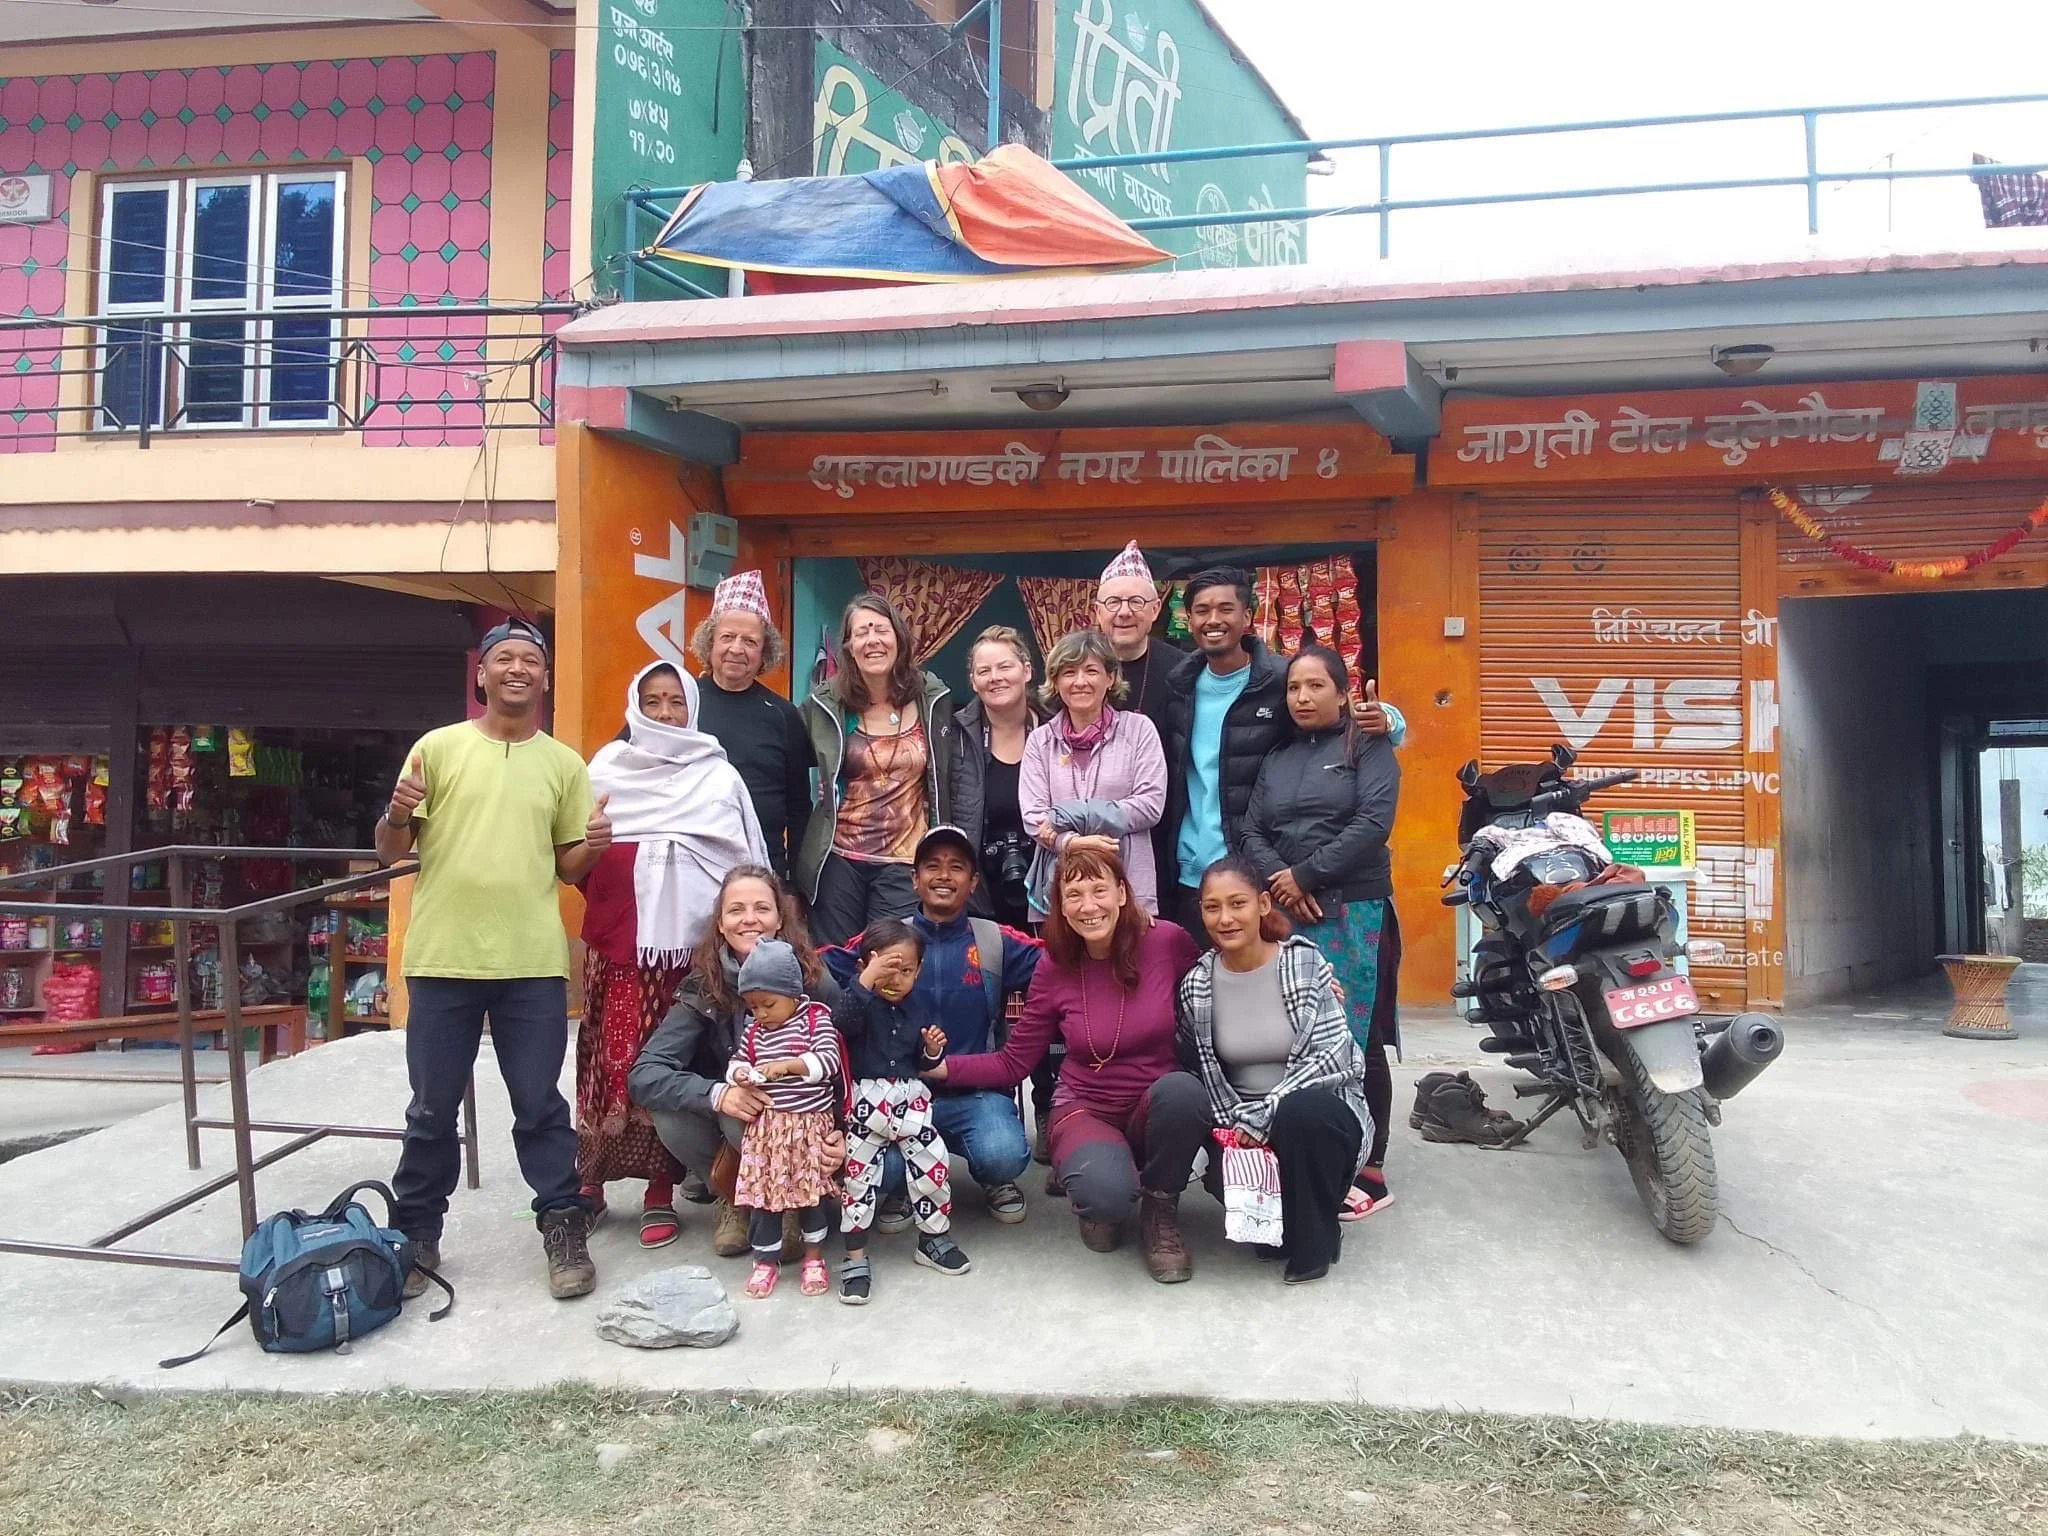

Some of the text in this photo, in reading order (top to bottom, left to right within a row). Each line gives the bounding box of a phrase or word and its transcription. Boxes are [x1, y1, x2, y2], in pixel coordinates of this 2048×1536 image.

[1457, 409, 1600, 469] जागृती
[1609, 406, 1693, 454] टोल
[1058, 450, 1145, 486] नगर
[1157, 433, 1298, 485] पालिका
[1315, 446, 1340, 480] ४
[1640, 767, 1711, 792] PIPES
[1613, 994, 1696, 1023] ८६८६
